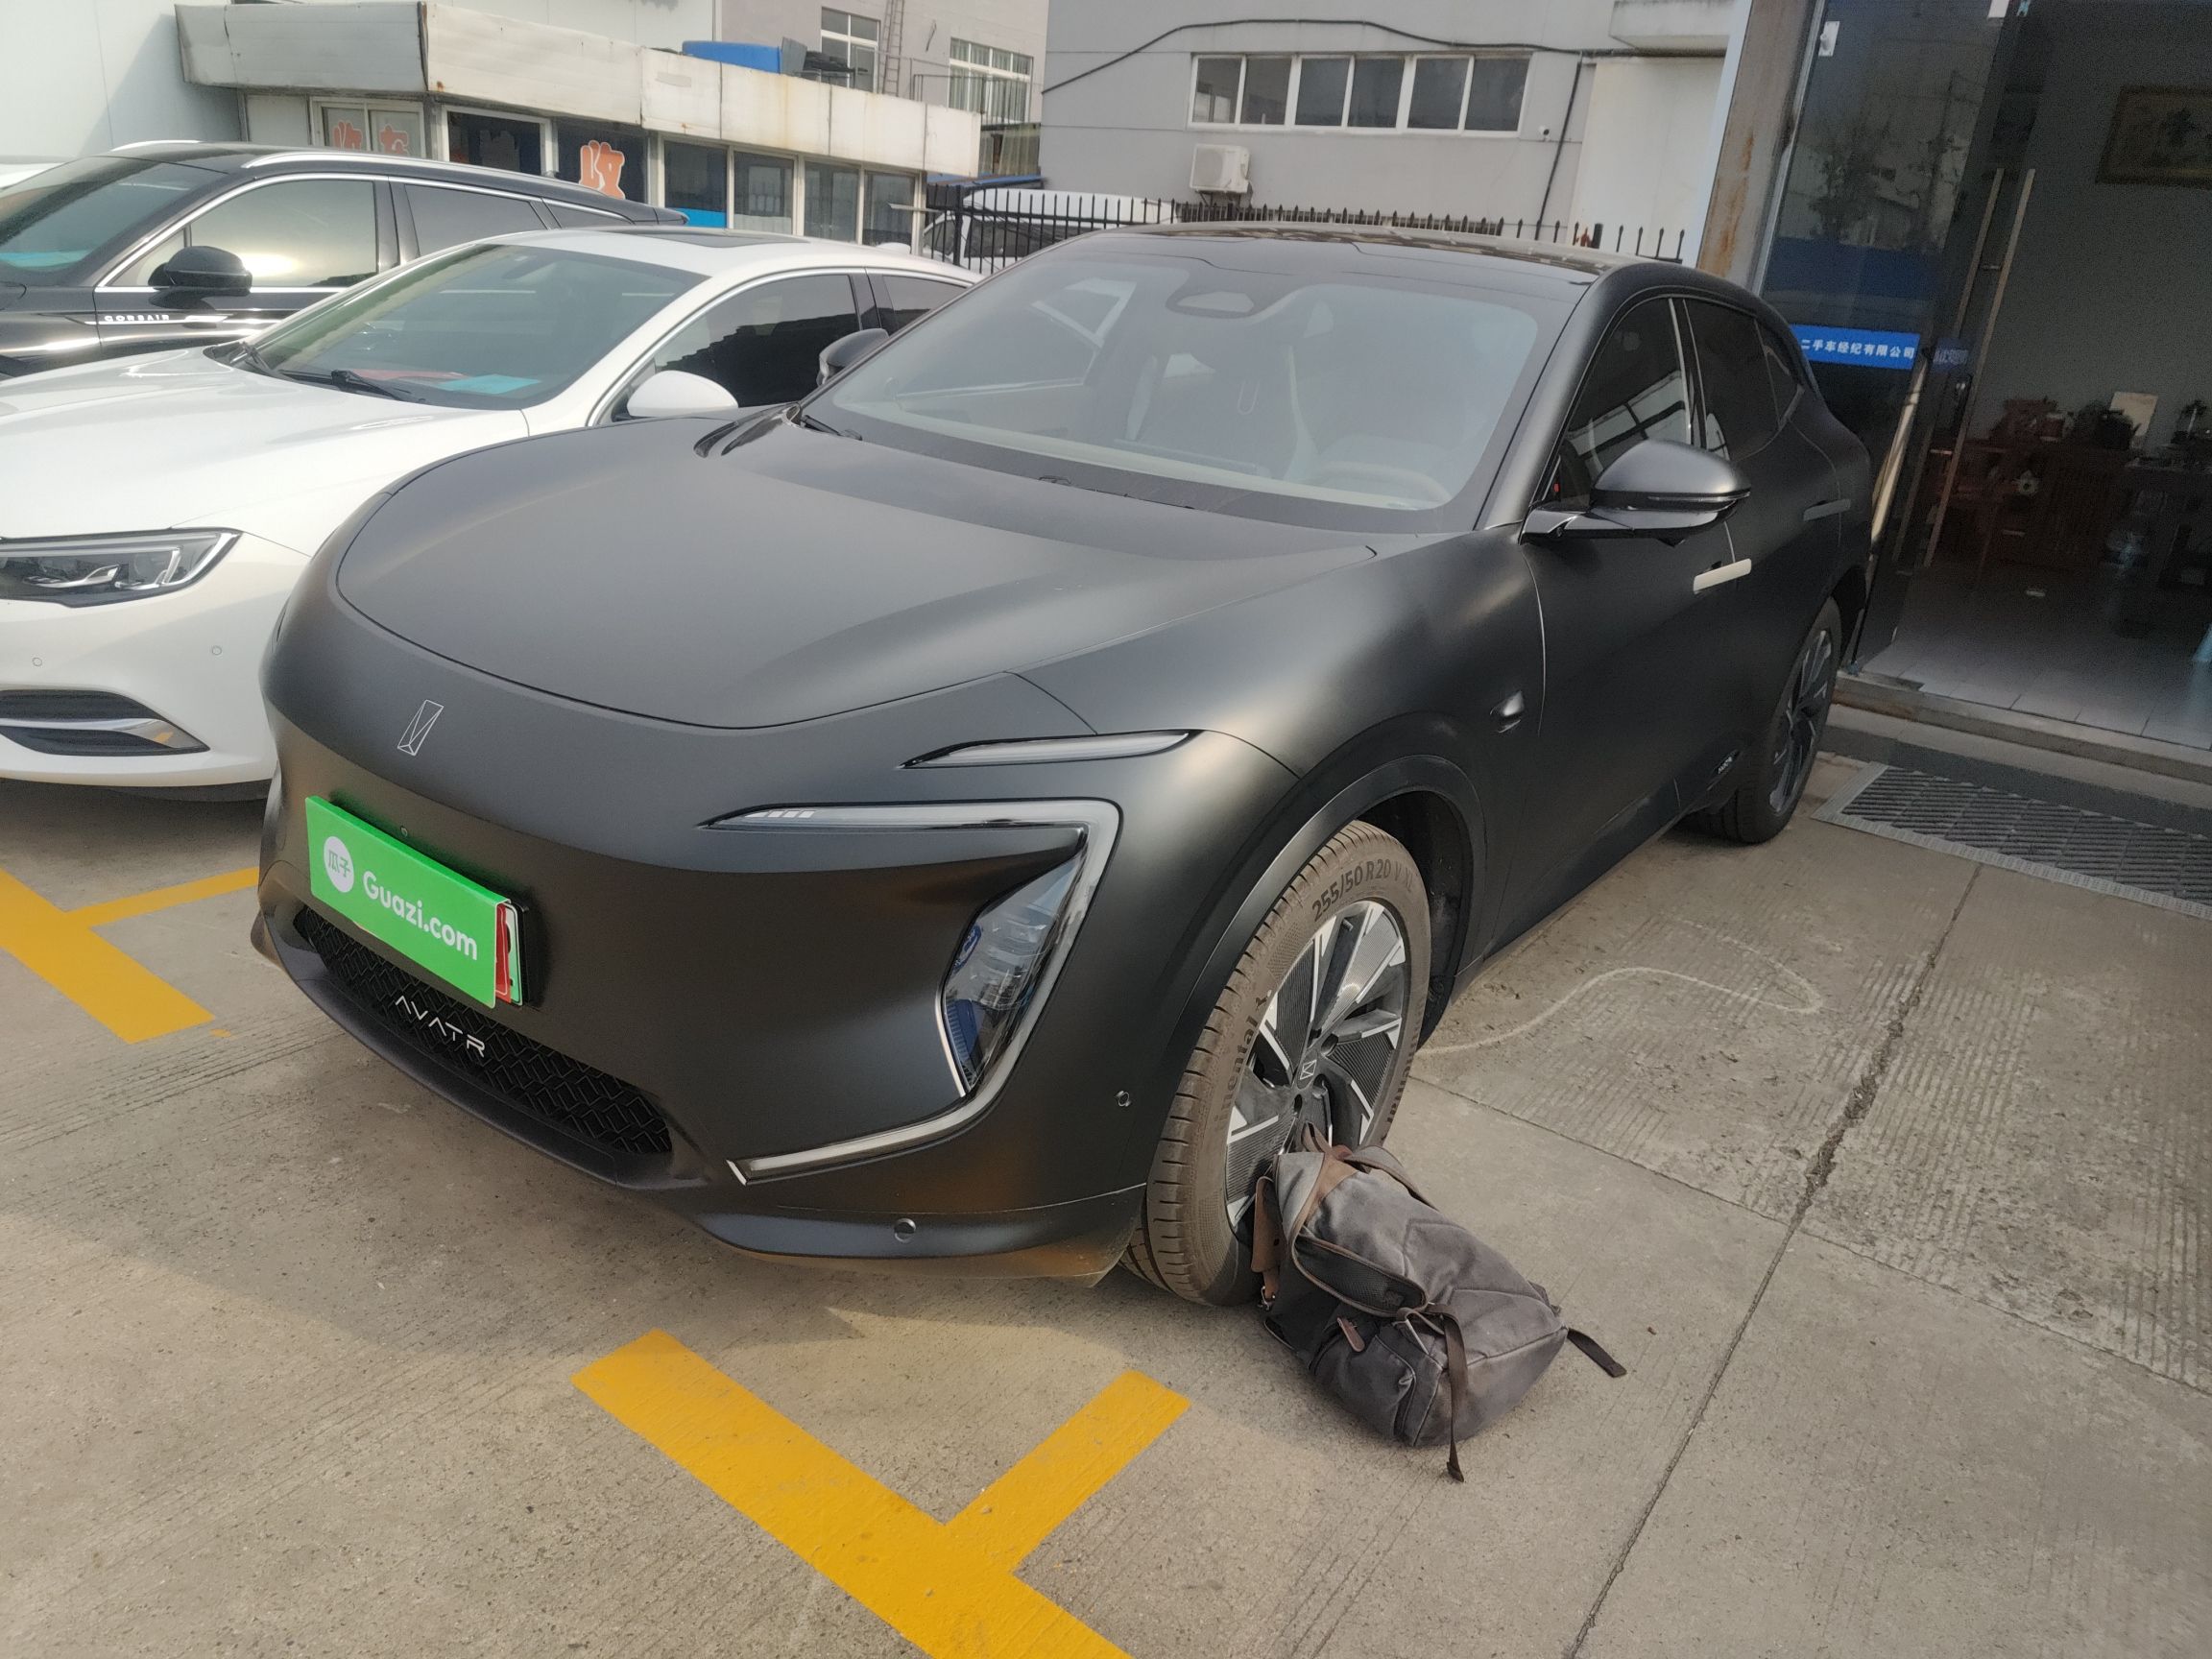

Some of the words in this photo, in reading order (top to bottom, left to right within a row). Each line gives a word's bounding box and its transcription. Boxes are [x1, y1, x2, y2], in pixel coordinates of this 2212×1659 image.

[104, 314, 170, 323] CORSAIR
[1801, 338, 1916, 360] 二手车经纪有限公司
[327, 848, 351, 878] 瓜子
[362, 870, 477, 961] Guazi.com
[1311, 864, 1364, 923] 255/50
[395, 995, 486, 1058] AVATR
